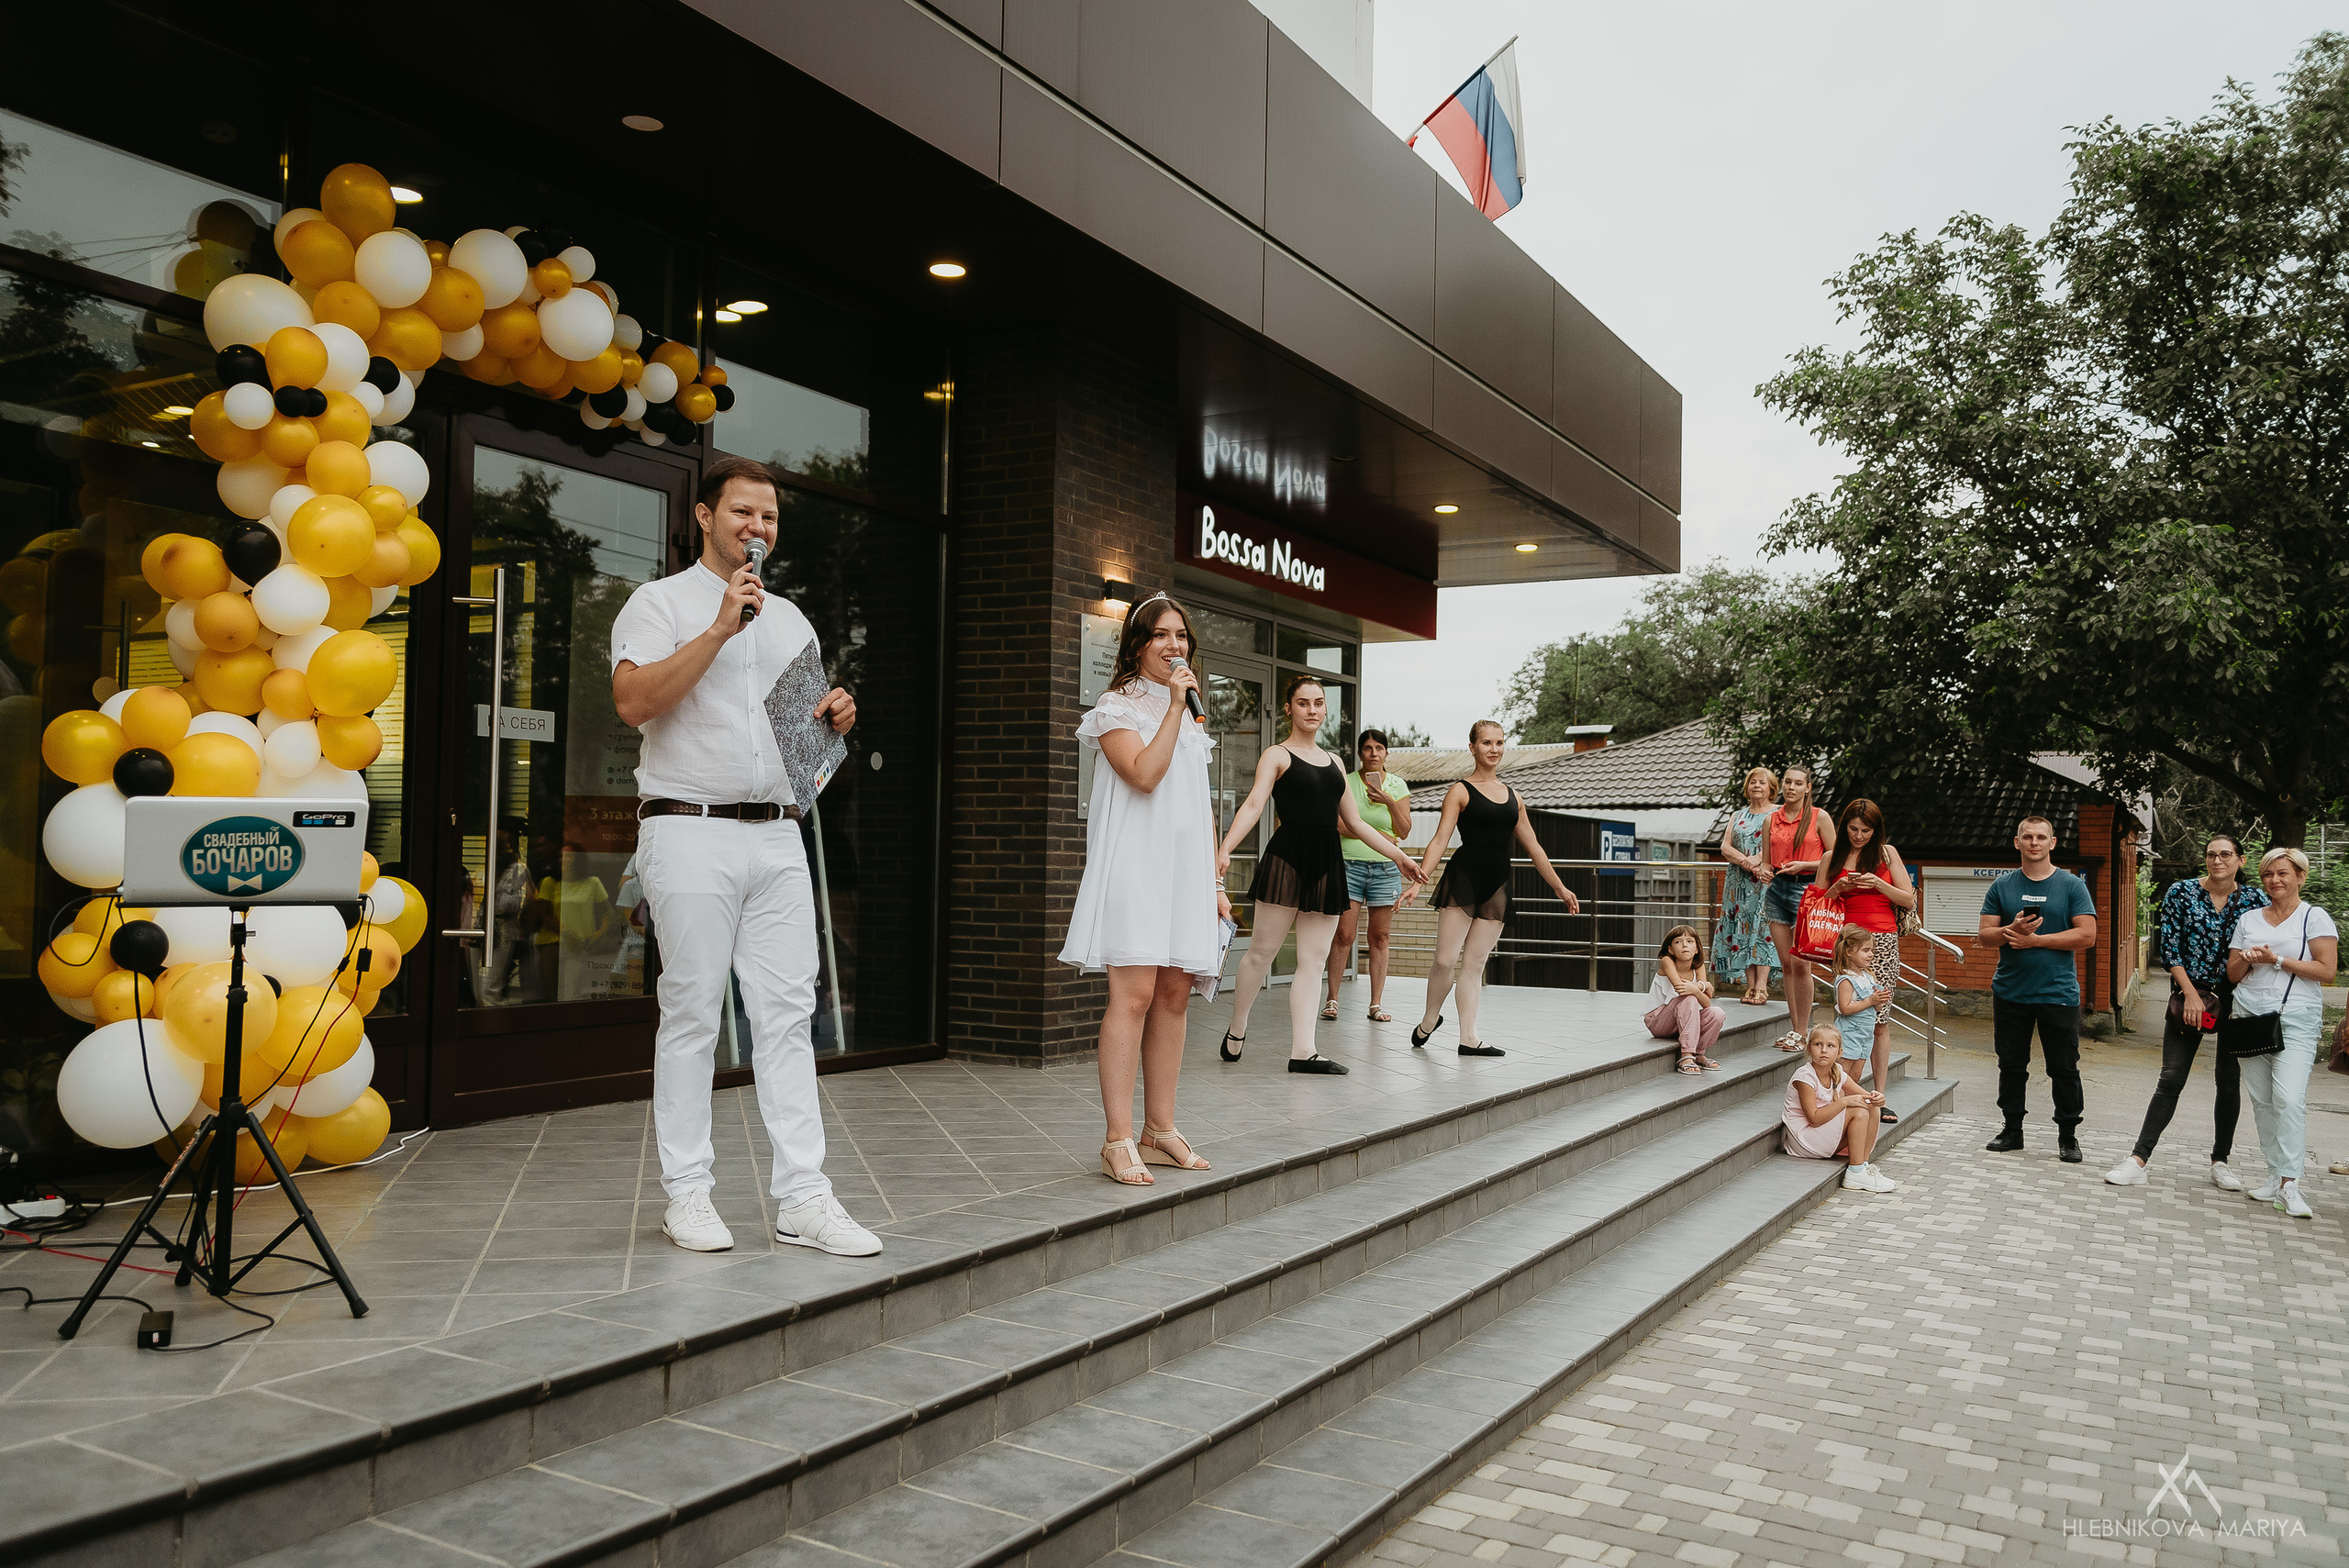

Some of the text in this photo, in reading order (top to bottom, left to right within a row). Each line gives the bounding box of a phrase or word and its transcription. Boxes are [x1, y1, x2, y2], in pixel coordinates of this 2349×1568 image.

[1201, 505, 1325, 592] Bossa Nova
[510, 716, 546, 731] СЕБЯ
[589, 807, 634, 820] 3 этаж
[204, 828, 280, 849] СВАДЕБНЫЙ
[192, 845, 293, 875] БОЧАРОВ
[1974, 869, 2013, 877] КСЕРО
